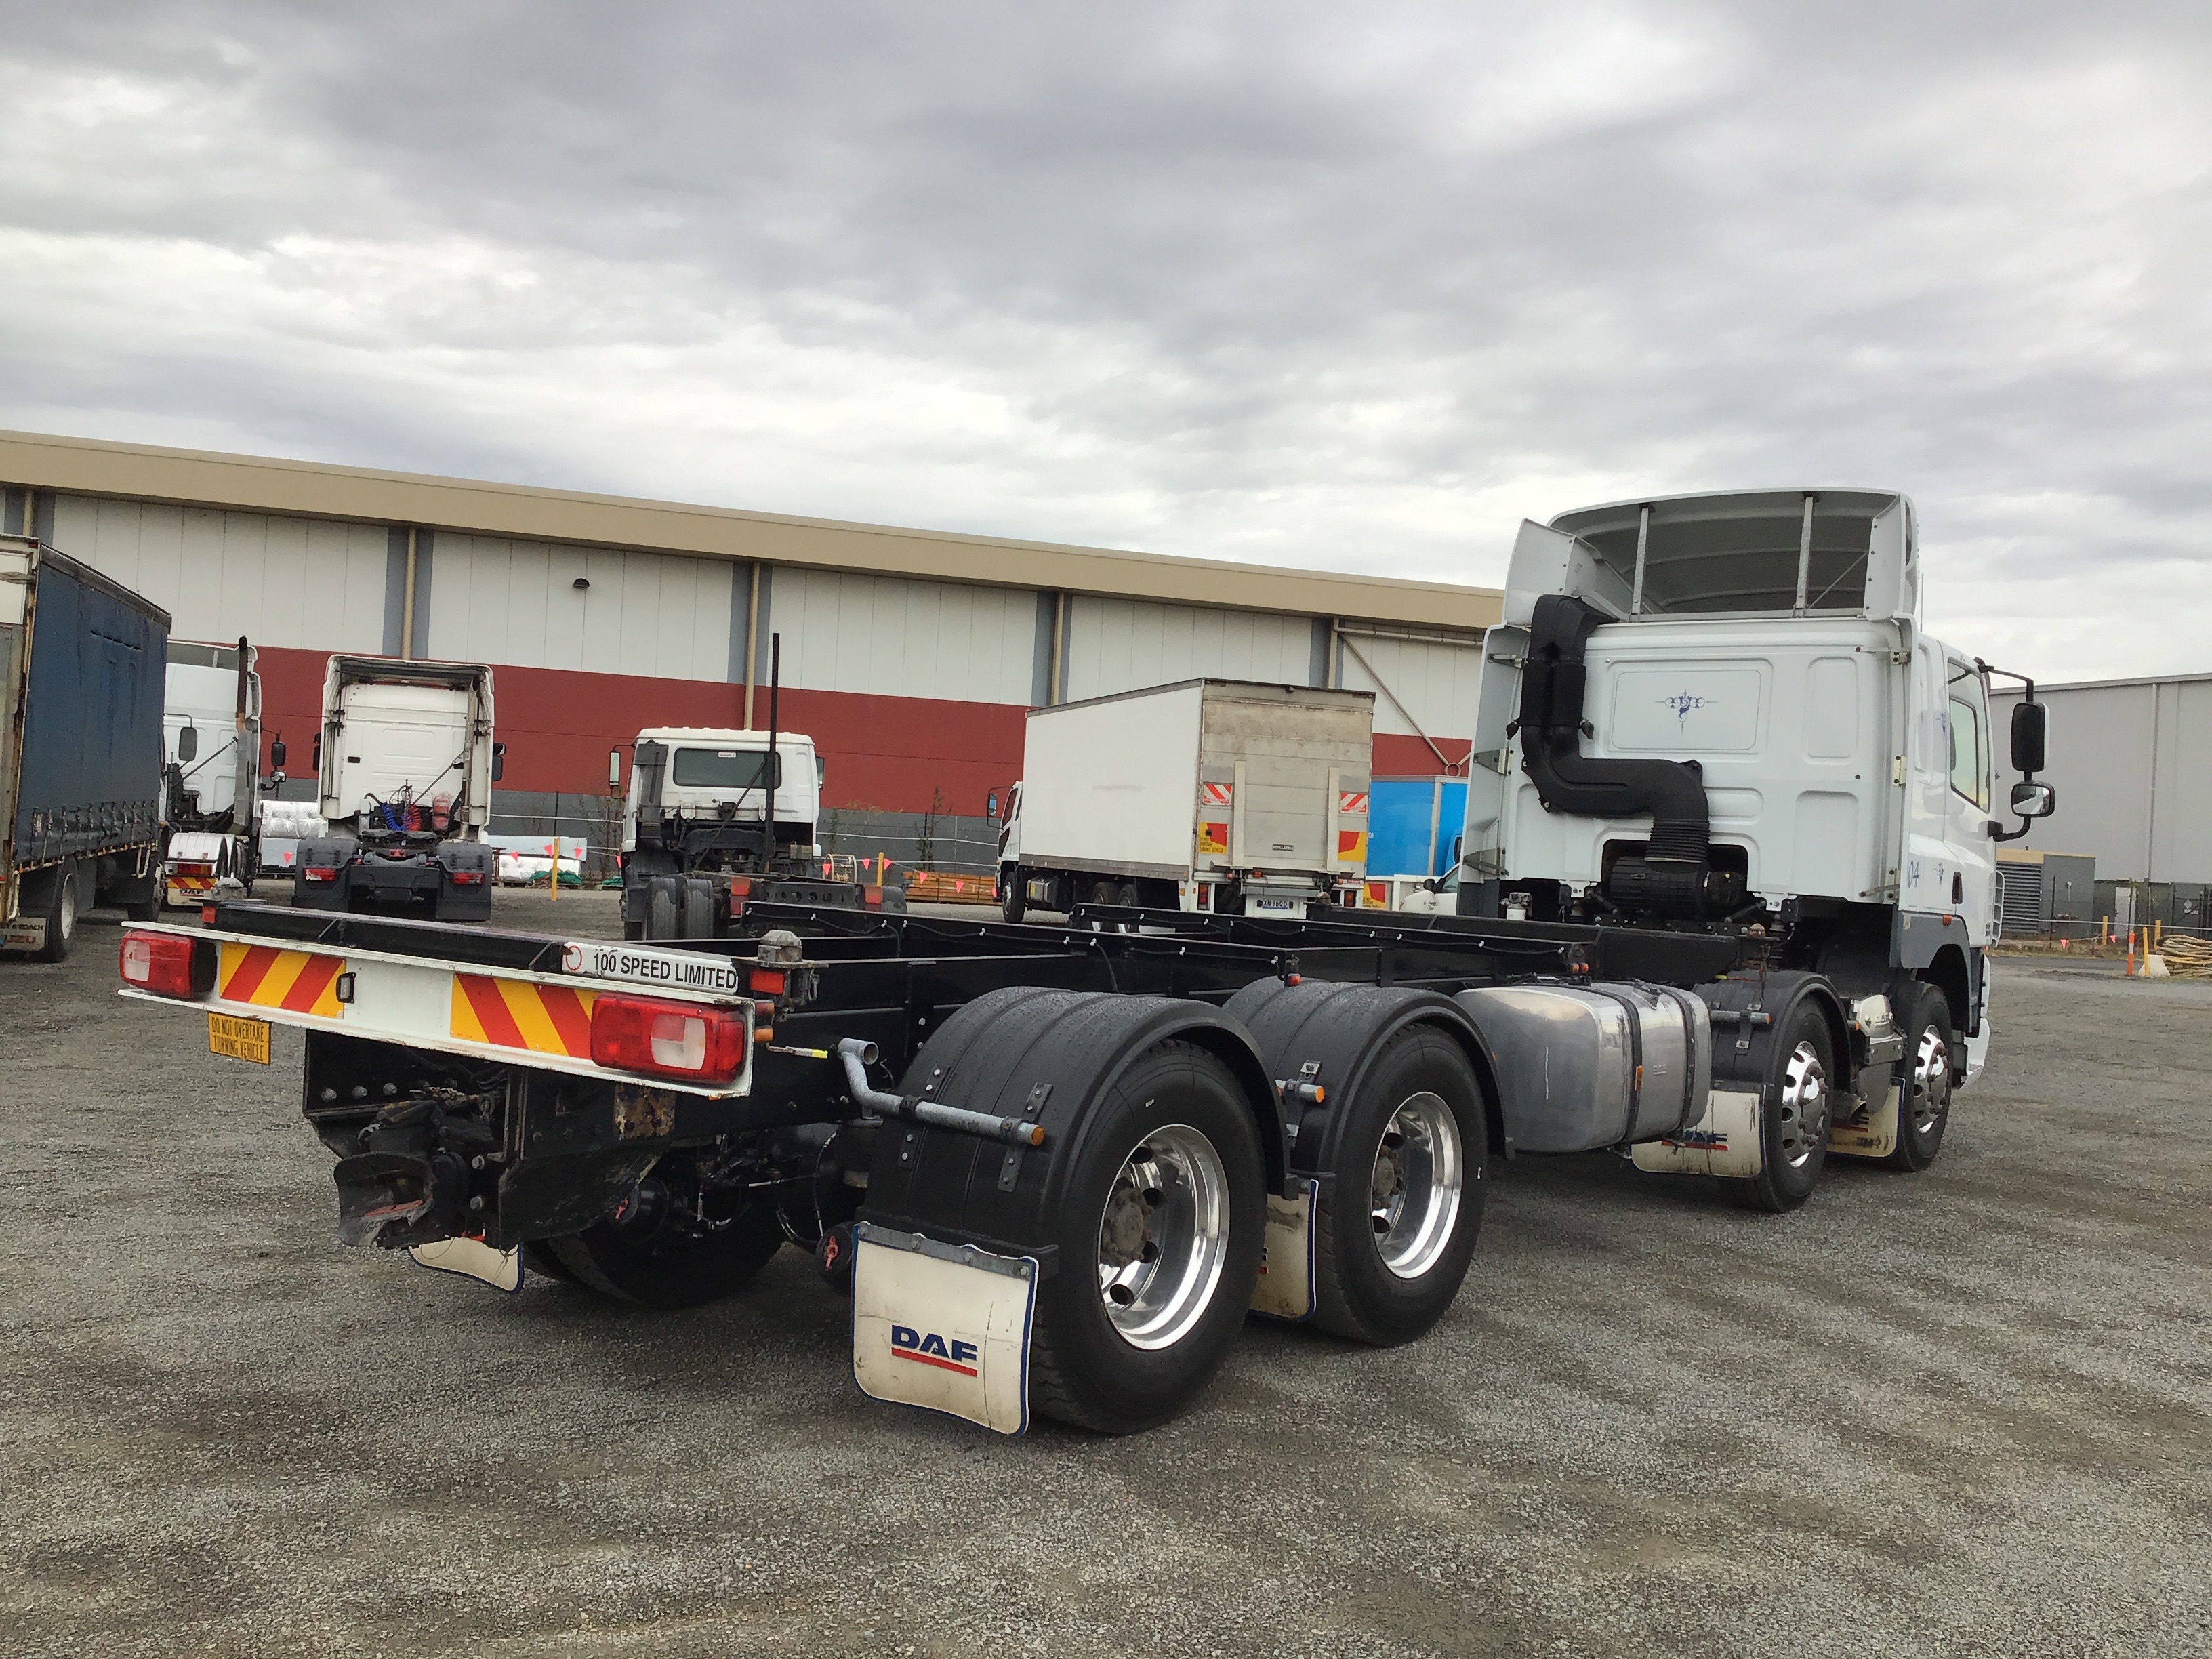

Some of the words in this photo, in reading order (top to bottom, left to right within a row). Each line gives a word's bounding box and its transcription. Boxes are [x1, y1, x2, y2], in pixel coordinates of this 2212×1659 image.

[593, 952, 617, 973] 100
[621, 956, 671, 979] SPEED
[675, 962, 737, 989] LIMITED
[211, 1017, 220, 1034] DO
[221, 1019, 232, 1036] NOT
[234, 1021, 264, 1043] OVERTAKE
[213, 1035, 239, 1056] TURNING
[240, 1041, 264, 1062] VEHICLE
[891, 1324, 978, 1362] DAF
